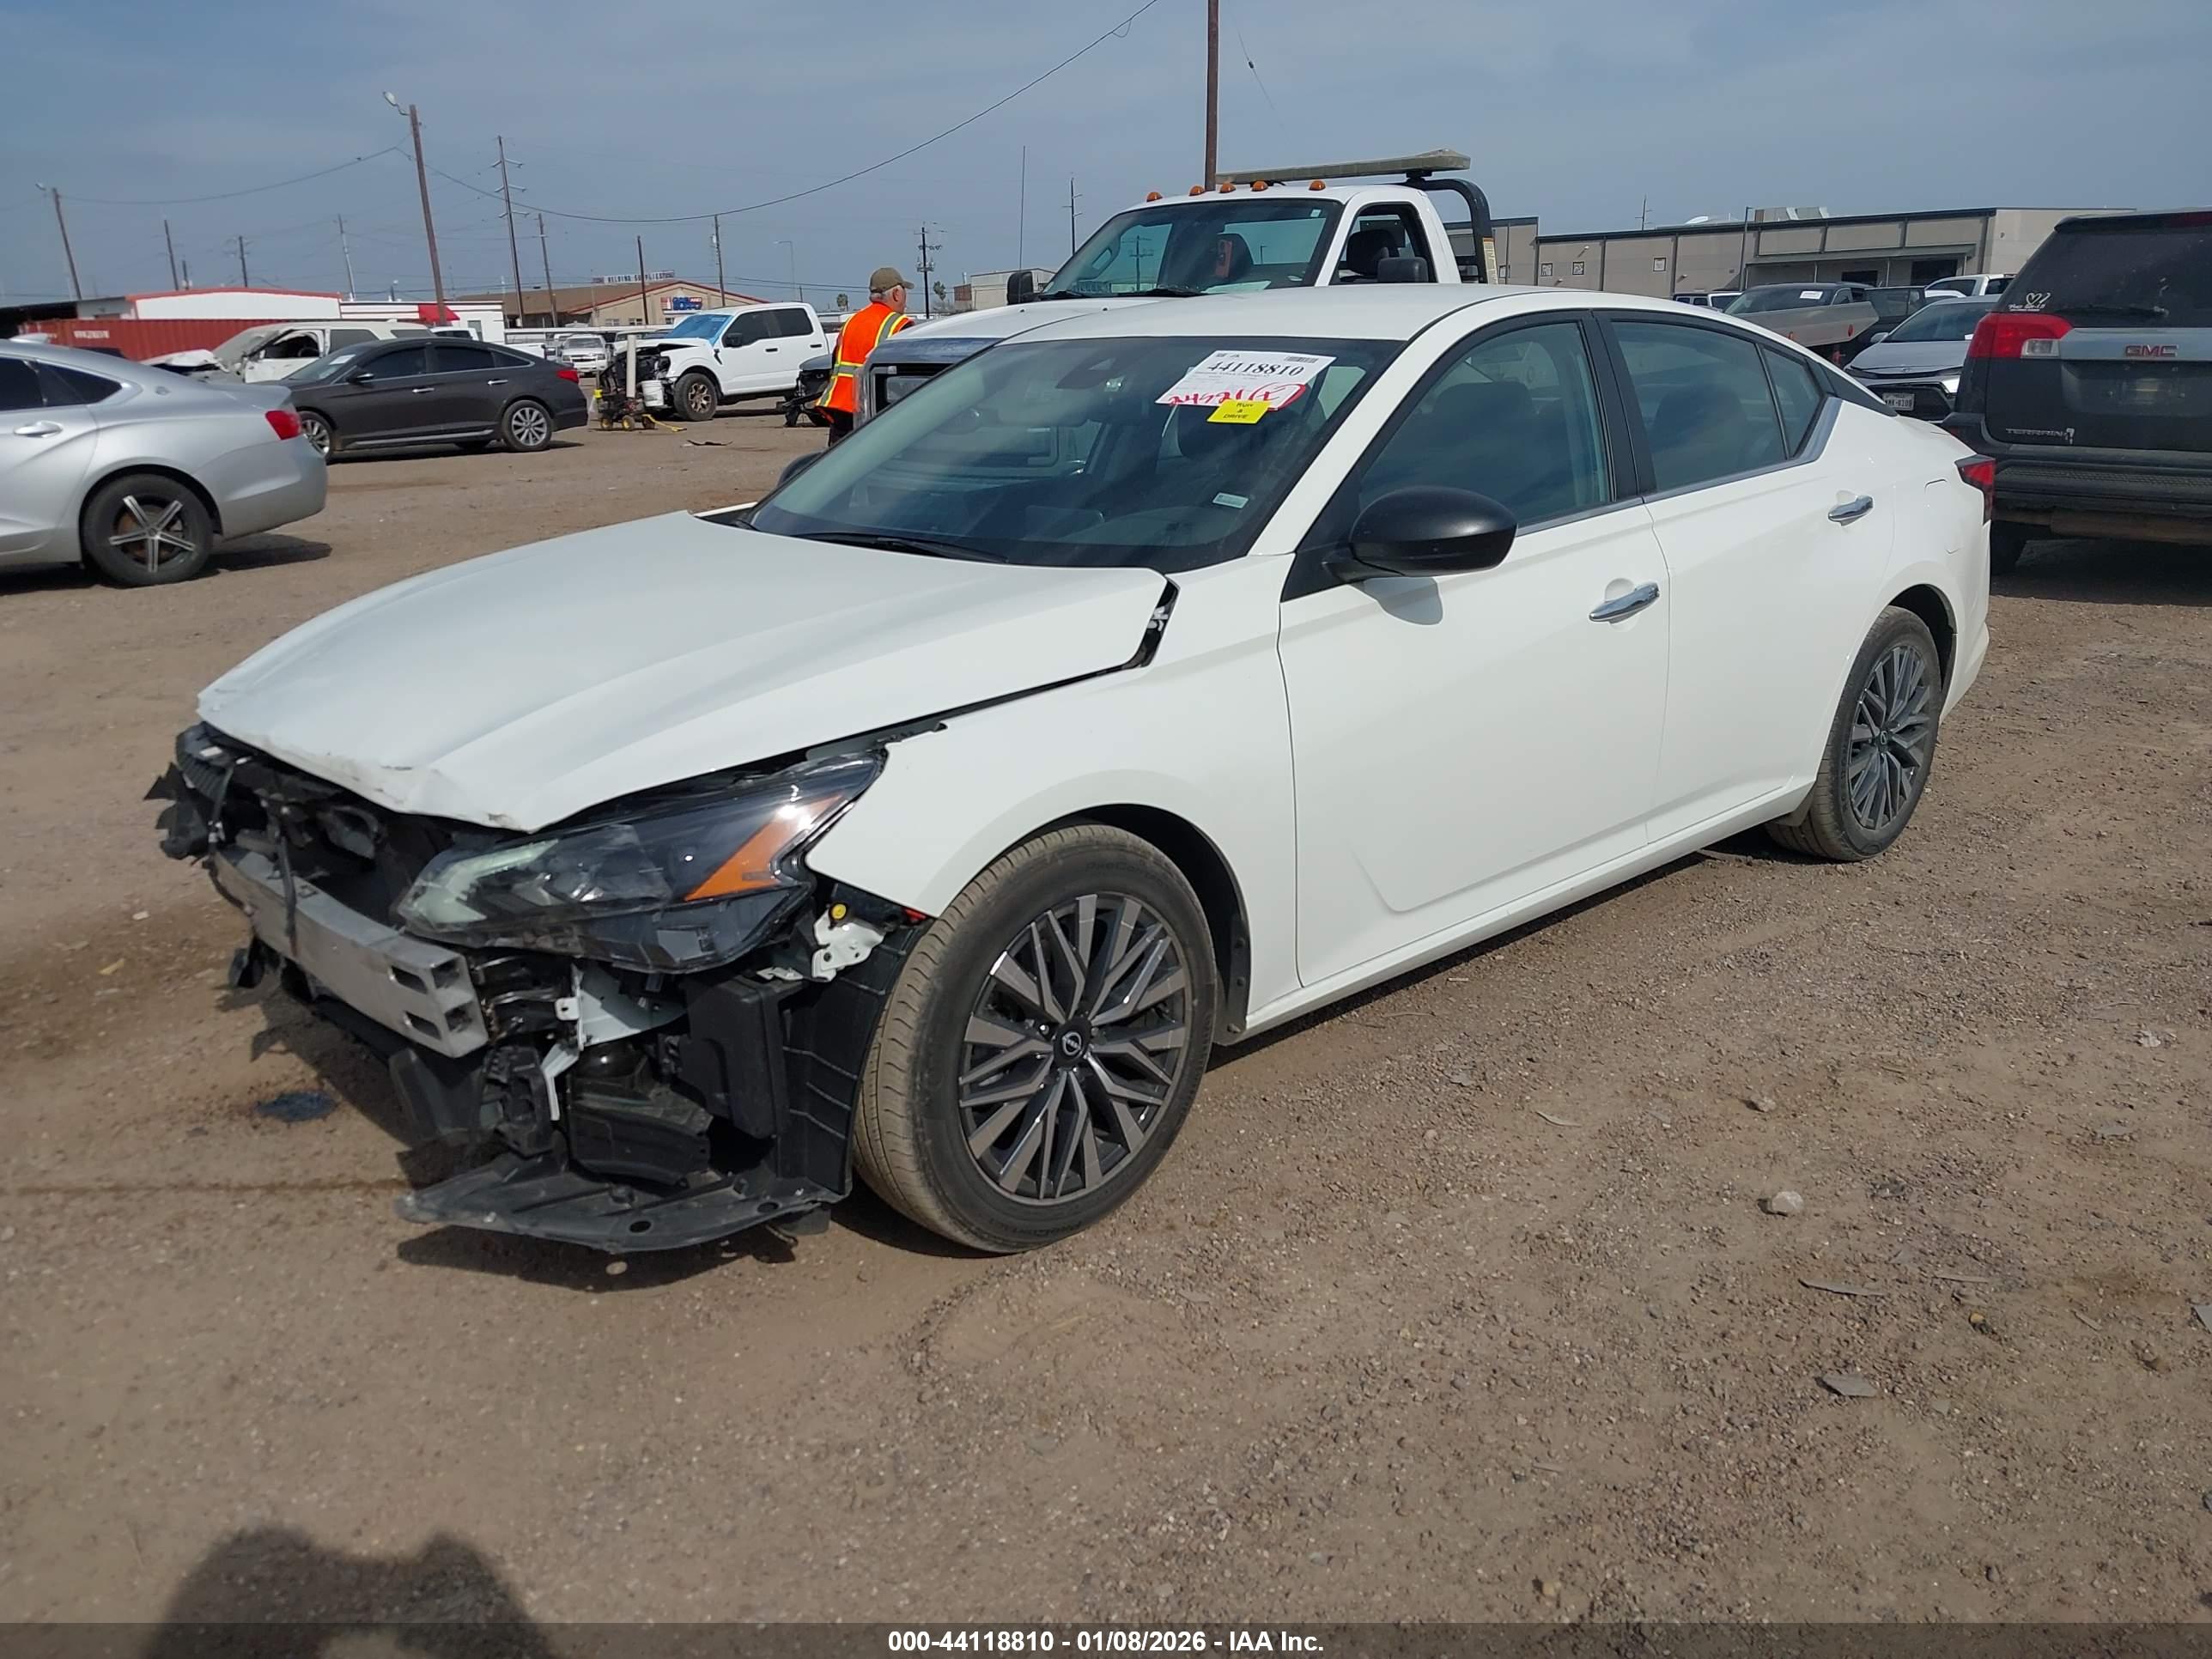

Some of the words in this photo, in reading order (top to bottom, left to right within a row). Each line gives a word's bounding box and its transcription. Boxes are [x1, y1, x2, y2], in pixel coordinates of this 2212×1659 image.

[2124, 344, 2179, 357] GMC
[1207, 362, 1304, 376] 44118810
[2005, 428, 2063, 437] TERRAIN
